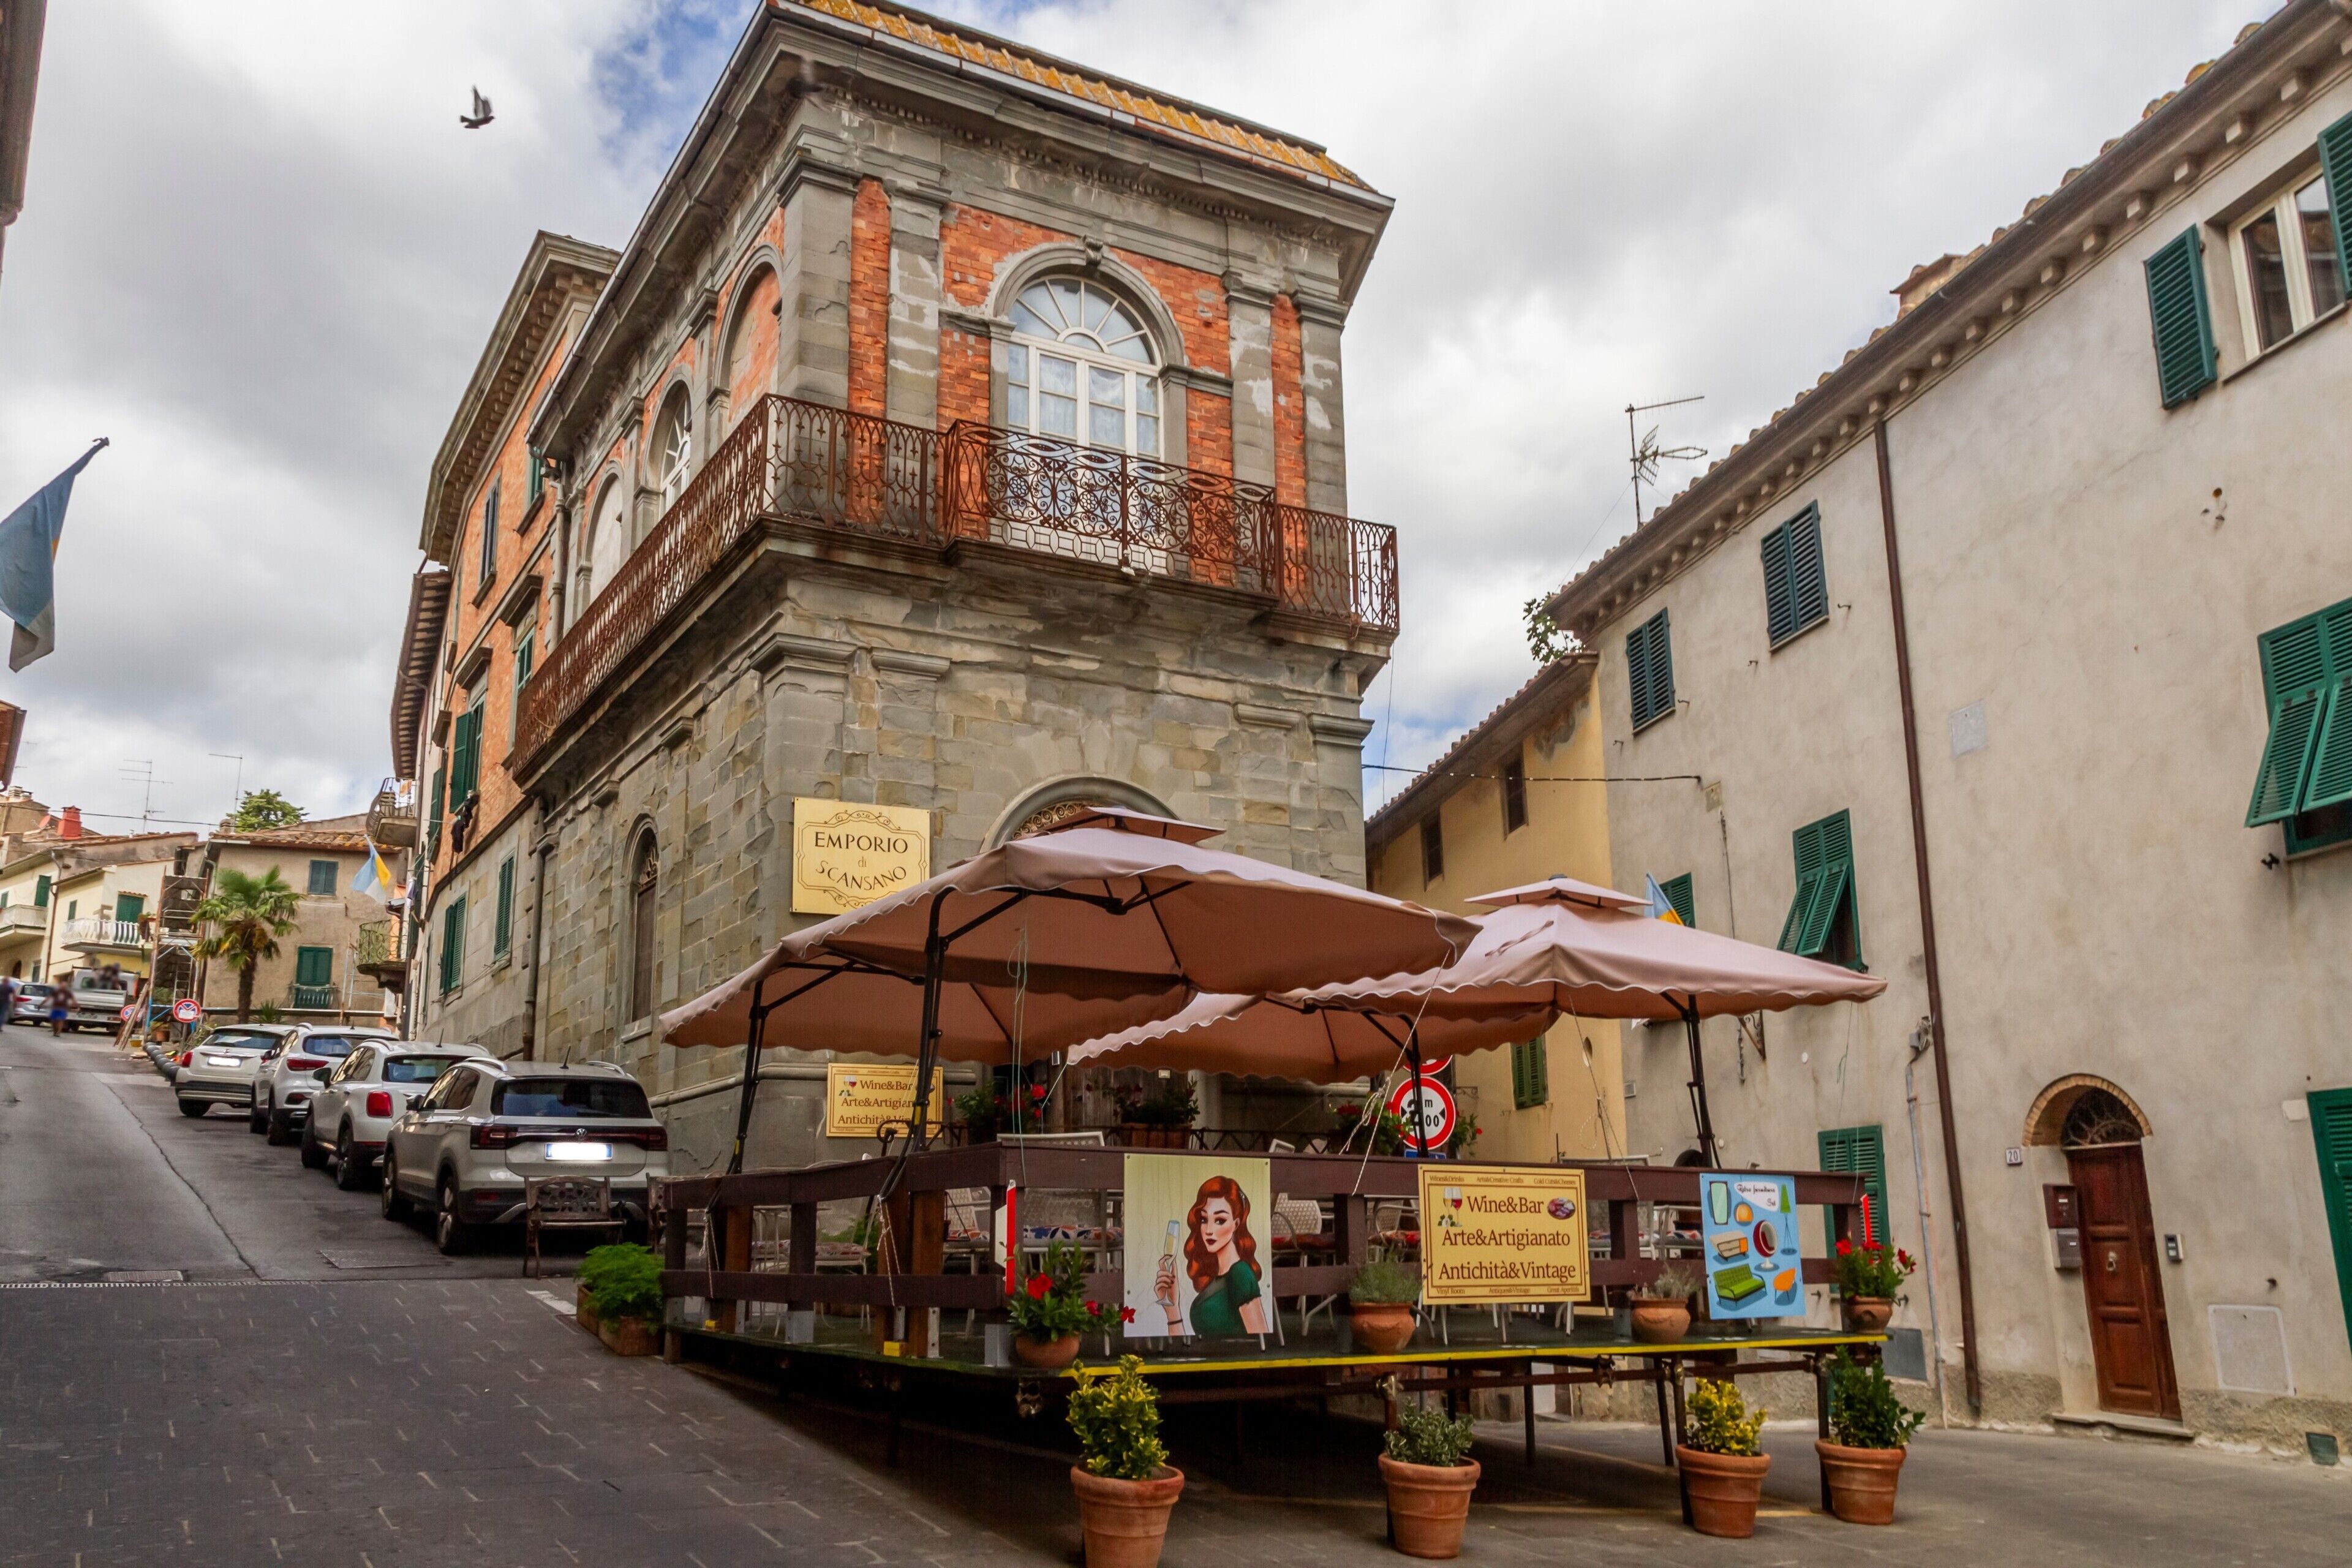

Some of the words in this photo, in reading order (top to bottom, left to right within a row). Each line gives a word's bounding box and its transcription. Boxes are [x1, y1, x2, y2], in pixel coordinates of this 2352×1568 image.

[815, 831, 908, 854] EMPORIO
[858, 856, 867, 867] di
[815, 860, 907, 891] SCANSANO
[860, 1080, 913, 1090] Wine&Bar
[1425, 1099, 1433, 1107] m
[2008, 1150, 2019, 1163] 20
[1467, 1195, 1544, 1214] Wine&Bar
[1442, 1228, 1570, 1251] Arte&Artigianato
[1438, 1260, 1576, 1283] Antichità&Vintage
